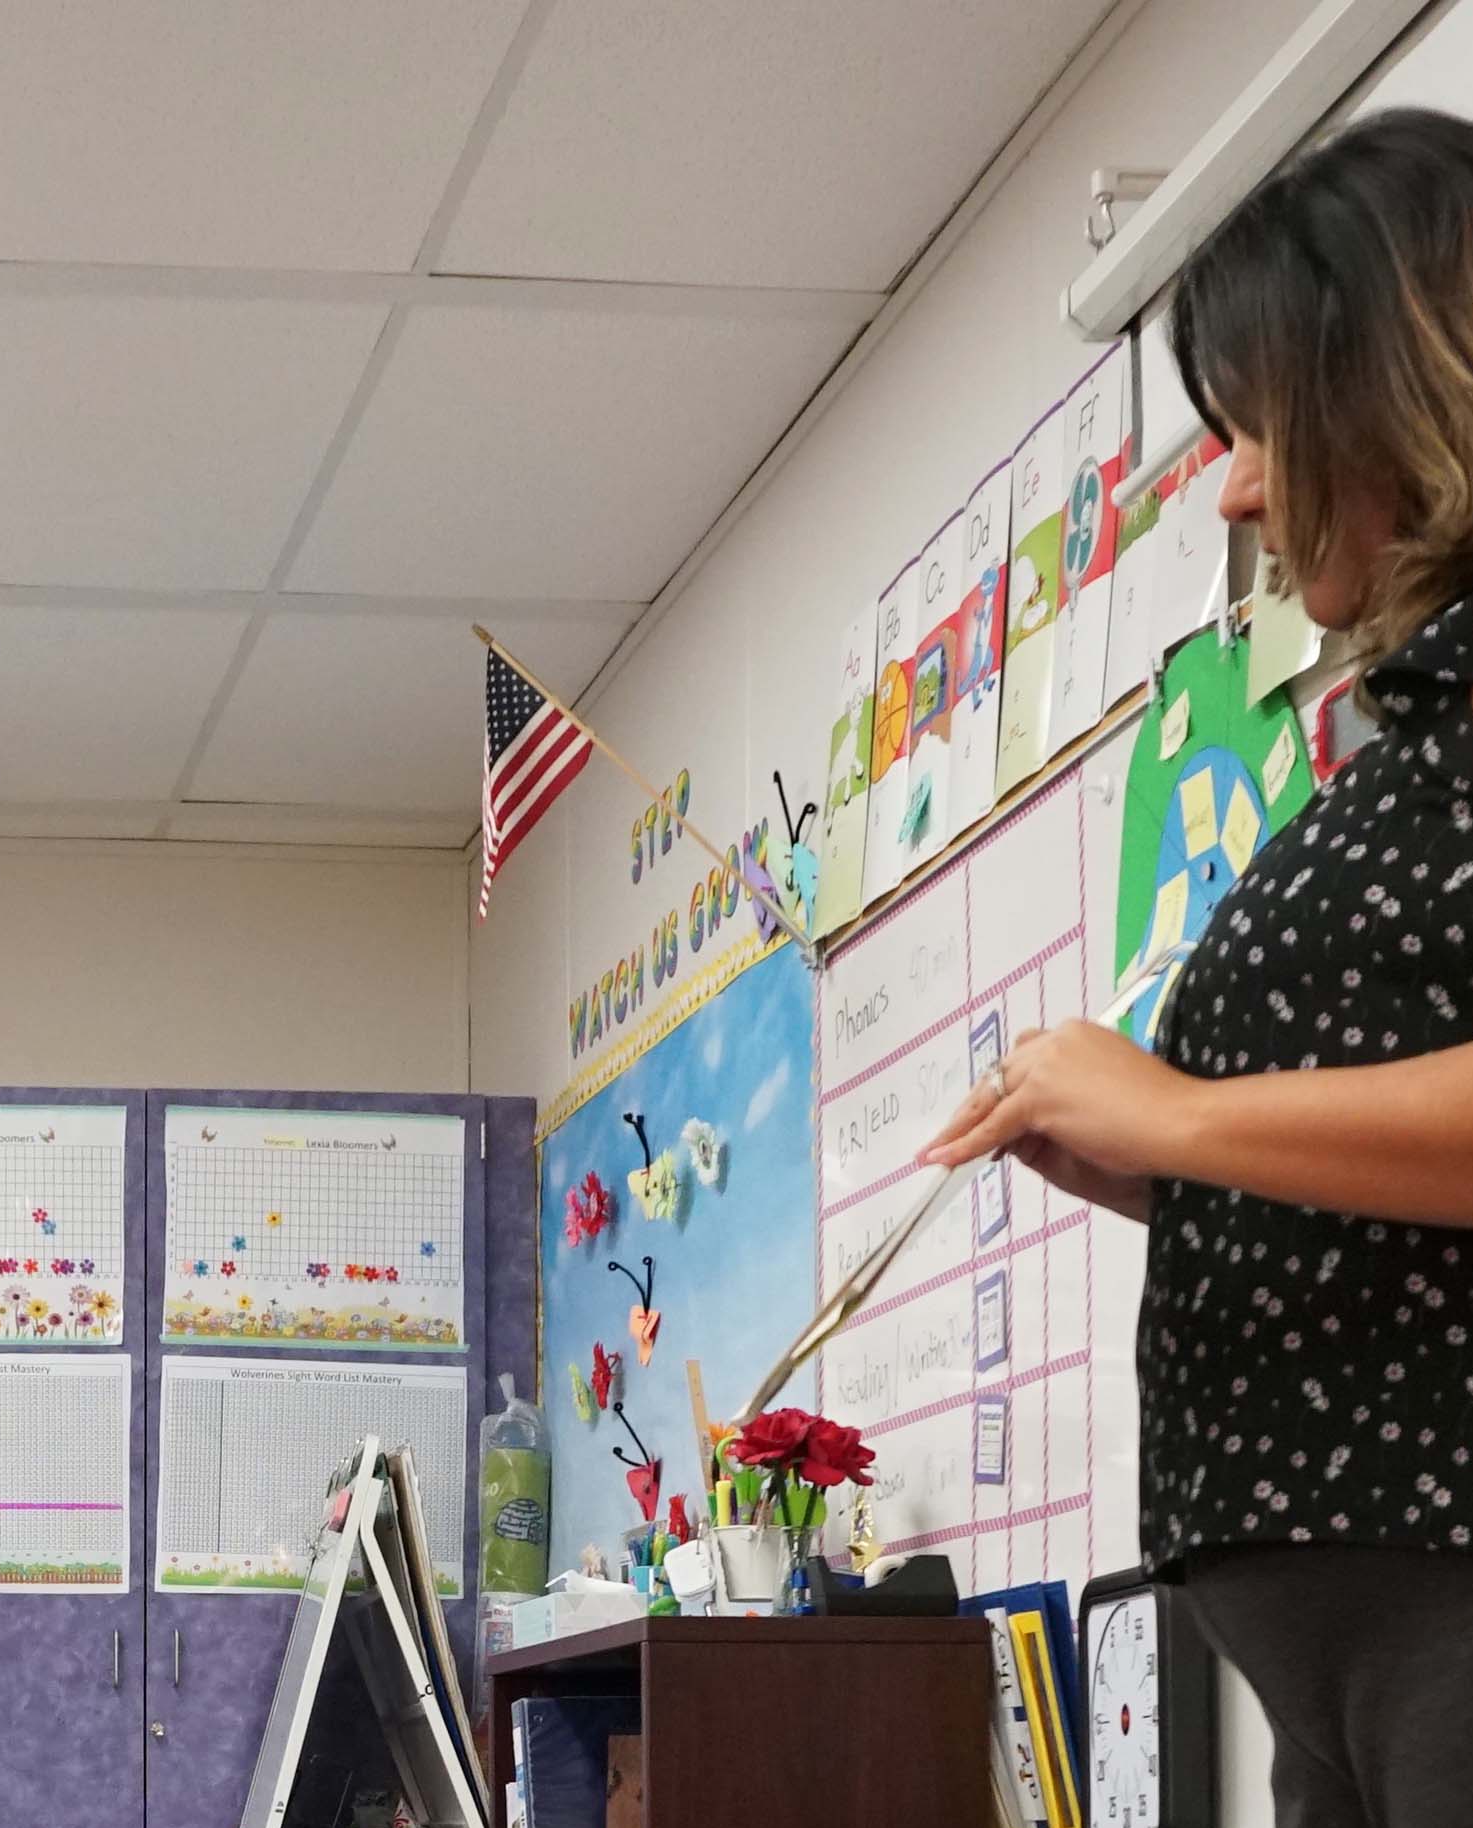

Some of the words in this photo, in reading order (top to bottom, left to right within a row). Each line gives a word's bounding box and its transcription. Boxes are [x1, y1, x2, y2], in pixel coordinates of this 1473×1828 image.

[1022, 457, 1040, 508] Ee
[970, 503, 992, 560] Dd
[631, 768, 690, 885] STEP
[569, 943, 645, 1059] WATCH
[652, 909, 678, 989] US
[835, 984, 889, 1059] Phonics
[307, 1139, 330, 1149] Lexia
[334, 1139, 378, 1150] Bloomers
[11, 1365, 51, 1376] Mastery
[231, 1368, 285, 1380] Wolverines
[287, 1371, 312, 1382] Sight
[314, 1372, 341, 1383] Word
[343, 1373, 360, 1383] List
[363, 1374, 402, 1385] Mastery
